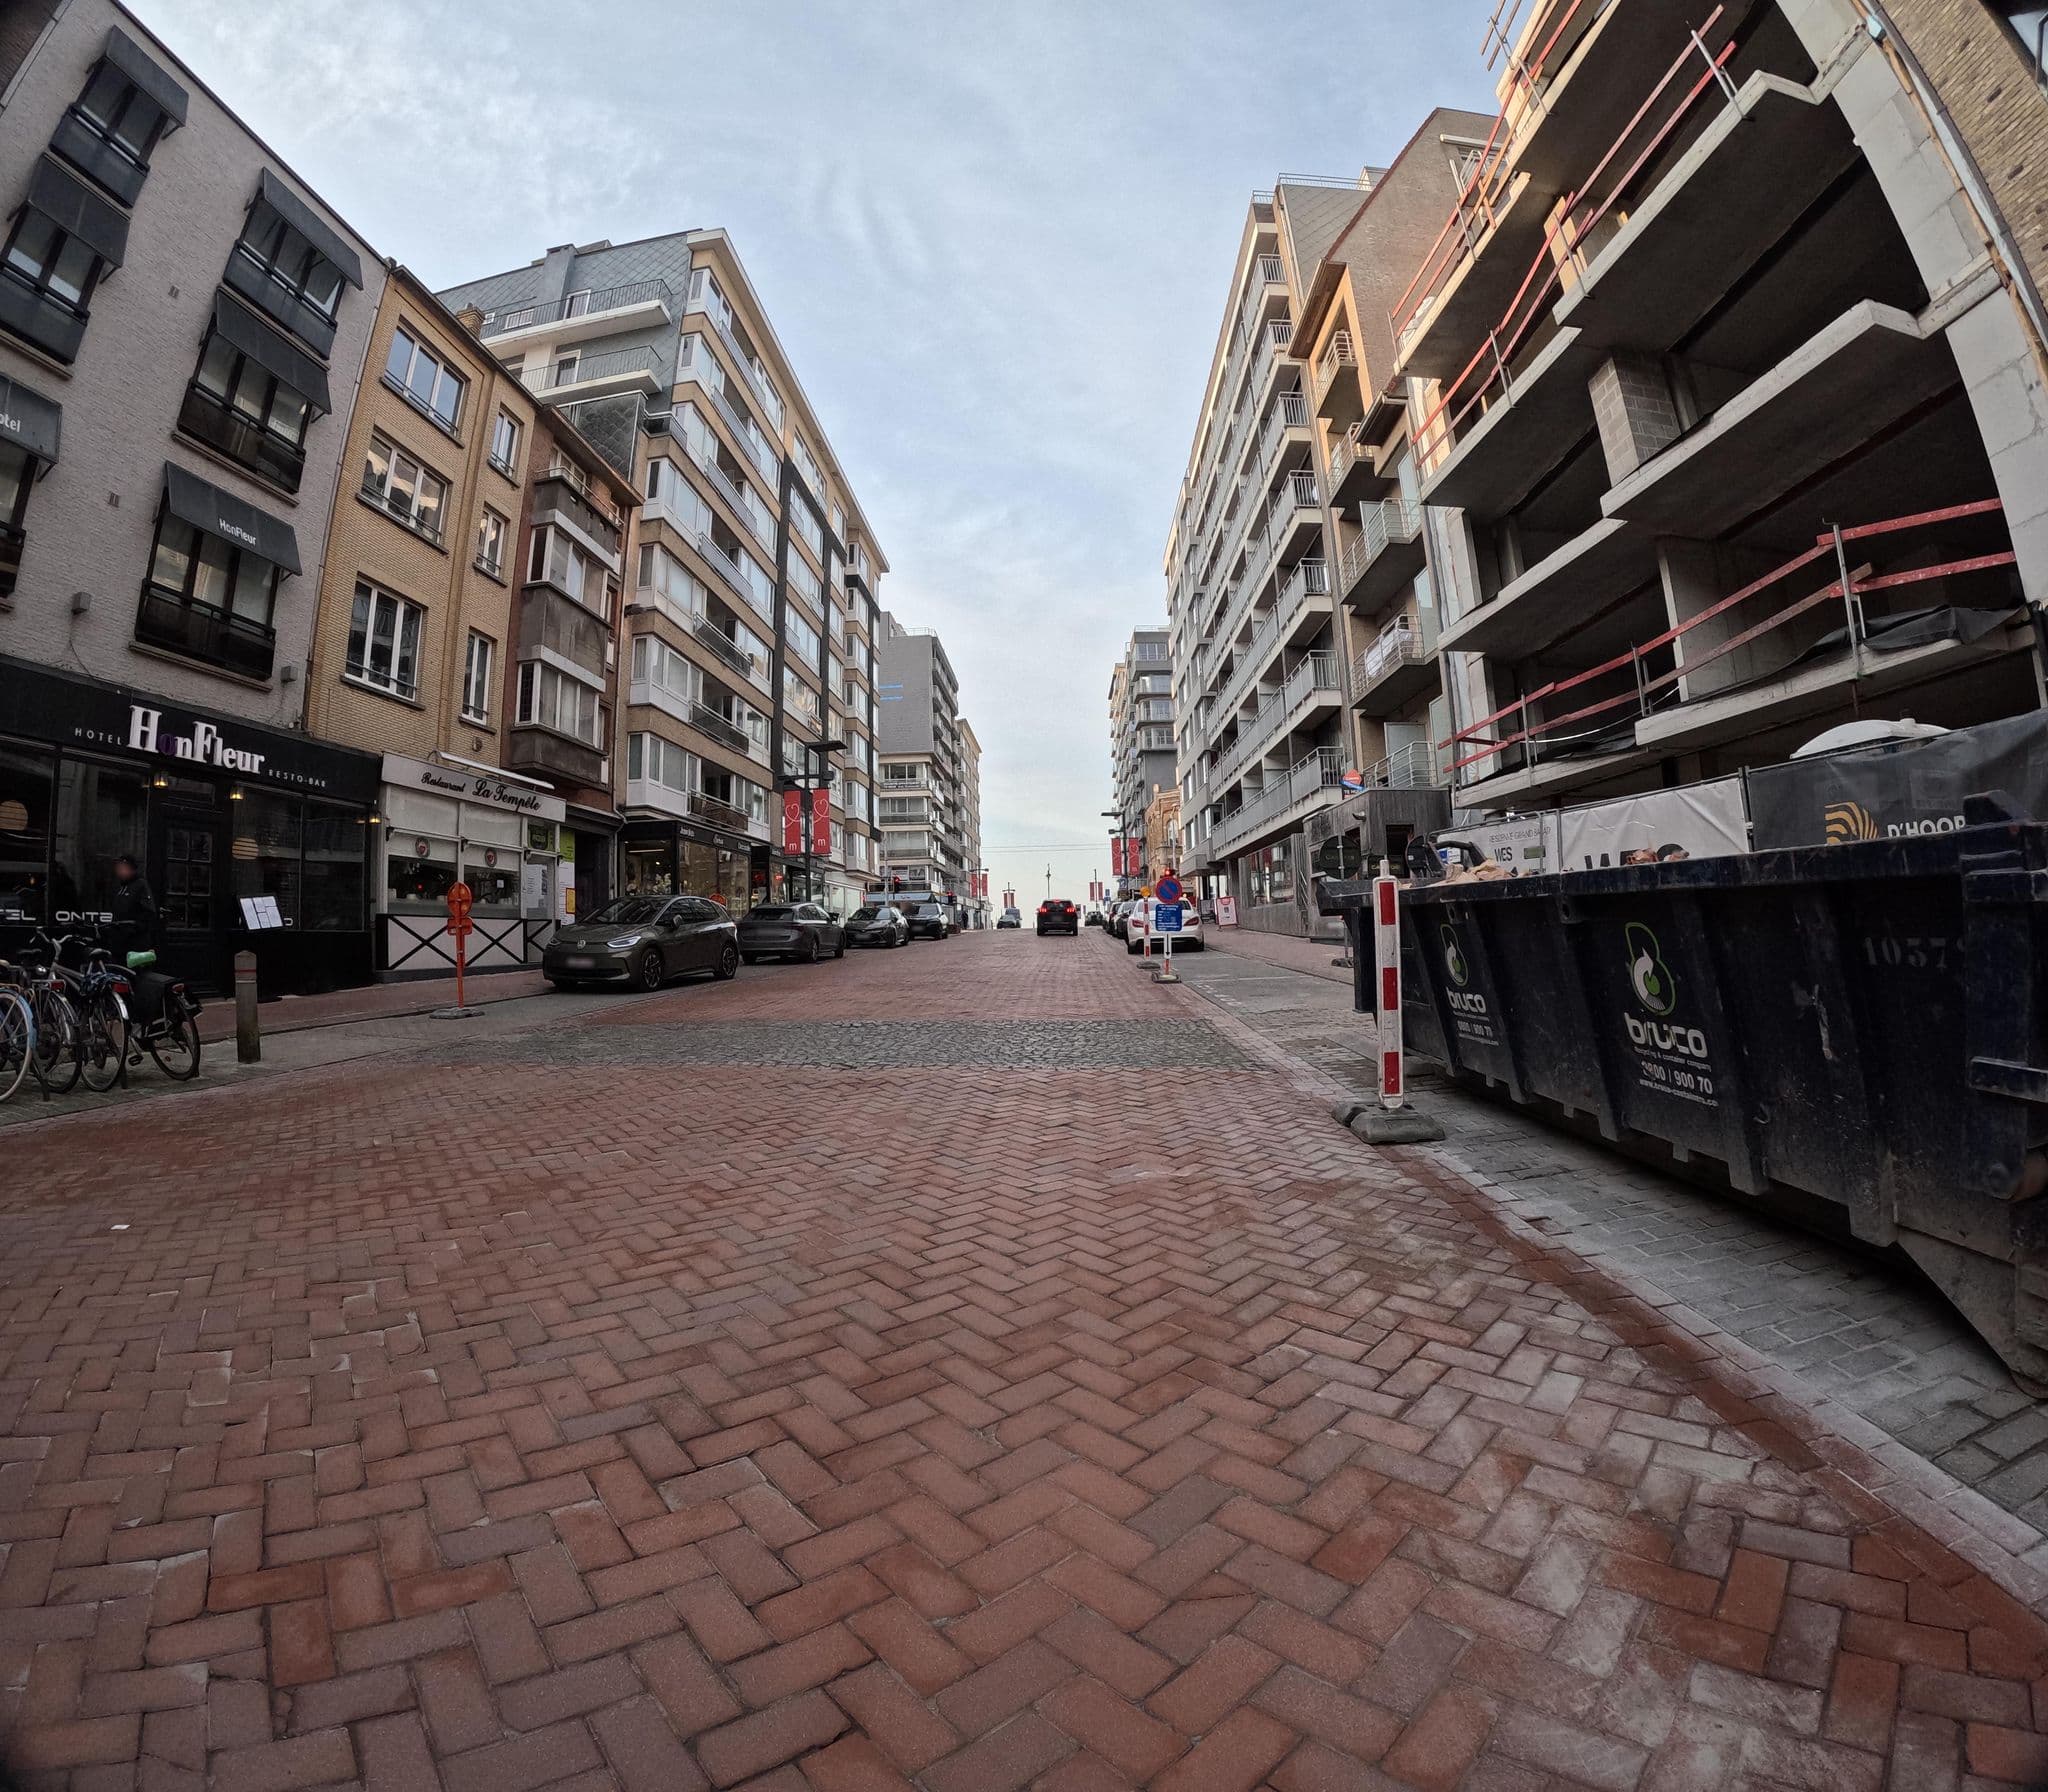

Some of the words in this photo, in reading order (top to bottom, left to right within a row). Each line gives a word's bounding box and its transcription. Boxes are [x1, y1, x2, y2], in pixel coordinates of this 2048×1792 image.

[219, 517, 258, 546] HonFleur
[74, 727, 121, 746] HOTEL
[127, 704, 265, 774] HonFleur
[268, 768, 326, 788] RESTO-BAR
[421, 771, 466, 793] Restaurant
[472, 779, 493, 798] La
[494, 785, 542, 812] Tempête
[1446, 985, 1487, 1014] bruco
[1624, 1011, 1709, 1058] bruco
[1674, 1070, 1695, 1090] 900
[1696, 1075, 1713, 1095] 70
